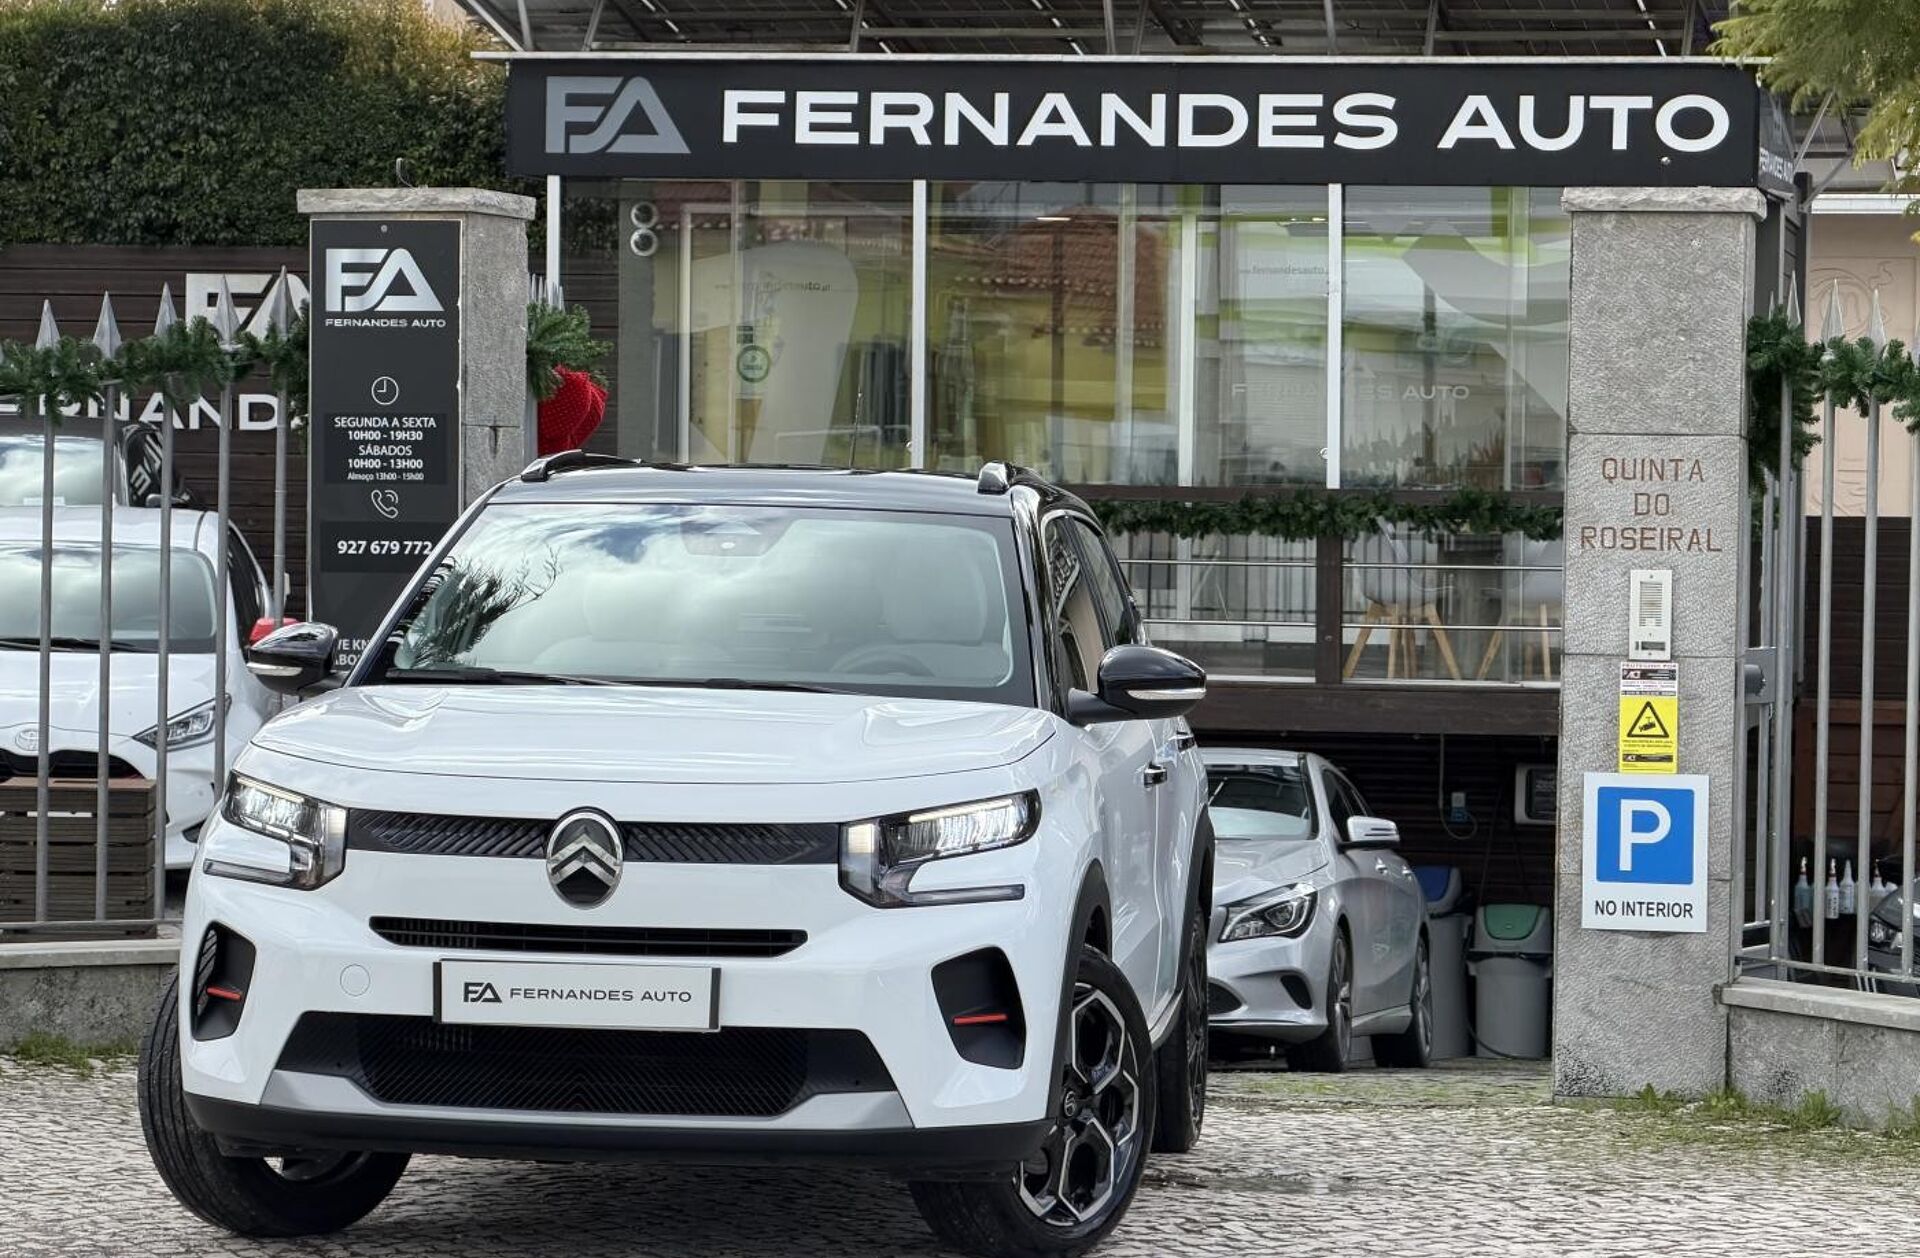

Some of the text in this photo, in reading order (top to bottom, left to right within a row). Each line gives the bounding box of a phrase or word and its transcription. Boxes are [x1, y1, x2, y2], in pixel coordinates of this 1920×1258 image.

[545, 76, 691, 154] FA
[723, 90, 1730, 153] FERNANDES AUTO
[325, 248, 445, 312] FA
[325, 318, 447, 328] FERNANDES AUTO
[1402, 385, 1470, 399] AUTO
[334, 417, 437, 428] SEGUNDA A SEXTA
[348, 430, 381, 441] 10H00
[390, 430, 424, 441] 19H30
[358, 443, 413, 456] SÁBADOS
[348, 459, 381, 469] 10H00
[390, 459, 424, 469] 13H00
[1602, 457, 1705, 484] QUINTA
[347, 472, 374, 483] Almoço
[1634, 493, 1670, 516] DO
[337, 540, 433, 555] 927 679 772
[1580, 526, 1723, 552] ROSEIRAL
[1619, 798, 1672, 872] P
[1594, 900, 1694, 918] NO INTERIOR
[463, 982, 692, 1003] FA FERNANDES AUTO
